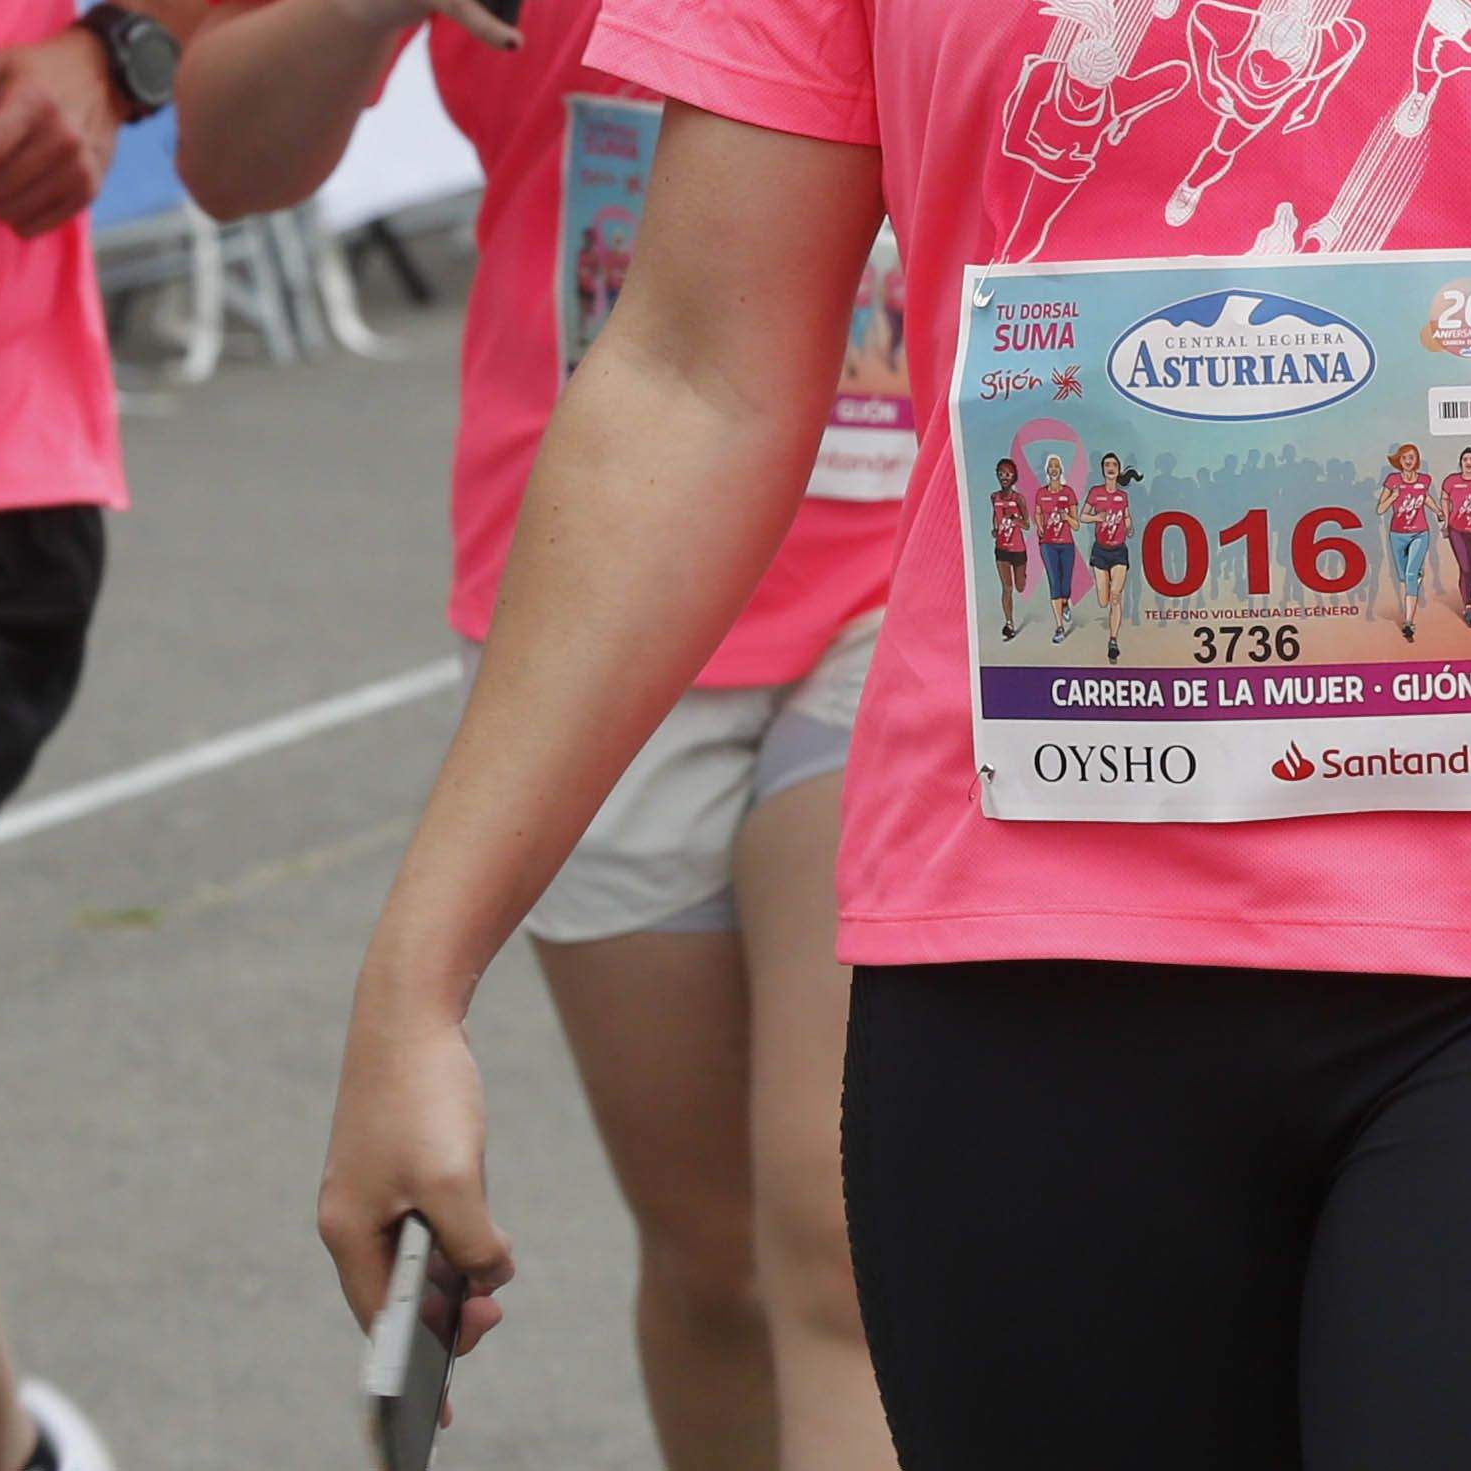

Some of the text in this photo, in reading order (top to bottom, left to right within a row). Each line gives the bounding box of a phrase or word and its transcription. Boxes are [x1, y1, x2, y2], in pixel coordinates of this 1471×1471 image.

[996, 302, 1080, 321] TU DORSAL
[993, 323, 1075, 353] SUMA
[1165, 332, 1345, 349] CENTRAL LECHERA
[1127, 340, 1356, 389] ASTURIANA
[979, 367, 1043, 401] gijón
[1140, 507, 1368, 599] 016
[1145, 604, 1360, 621] TELÉFONO VIOLENCIA DE GÉNERO
[1193, 624, 1301, 664] 3736
[1051, 678, 1166, 709] CARRERA
[1172, 679, 1209, 708] DE
[1217, 678, 1255, 707] LA
[1264, 675, 1365, 706] MUJER
[1033, 743, 1197, 785] OYSHO
